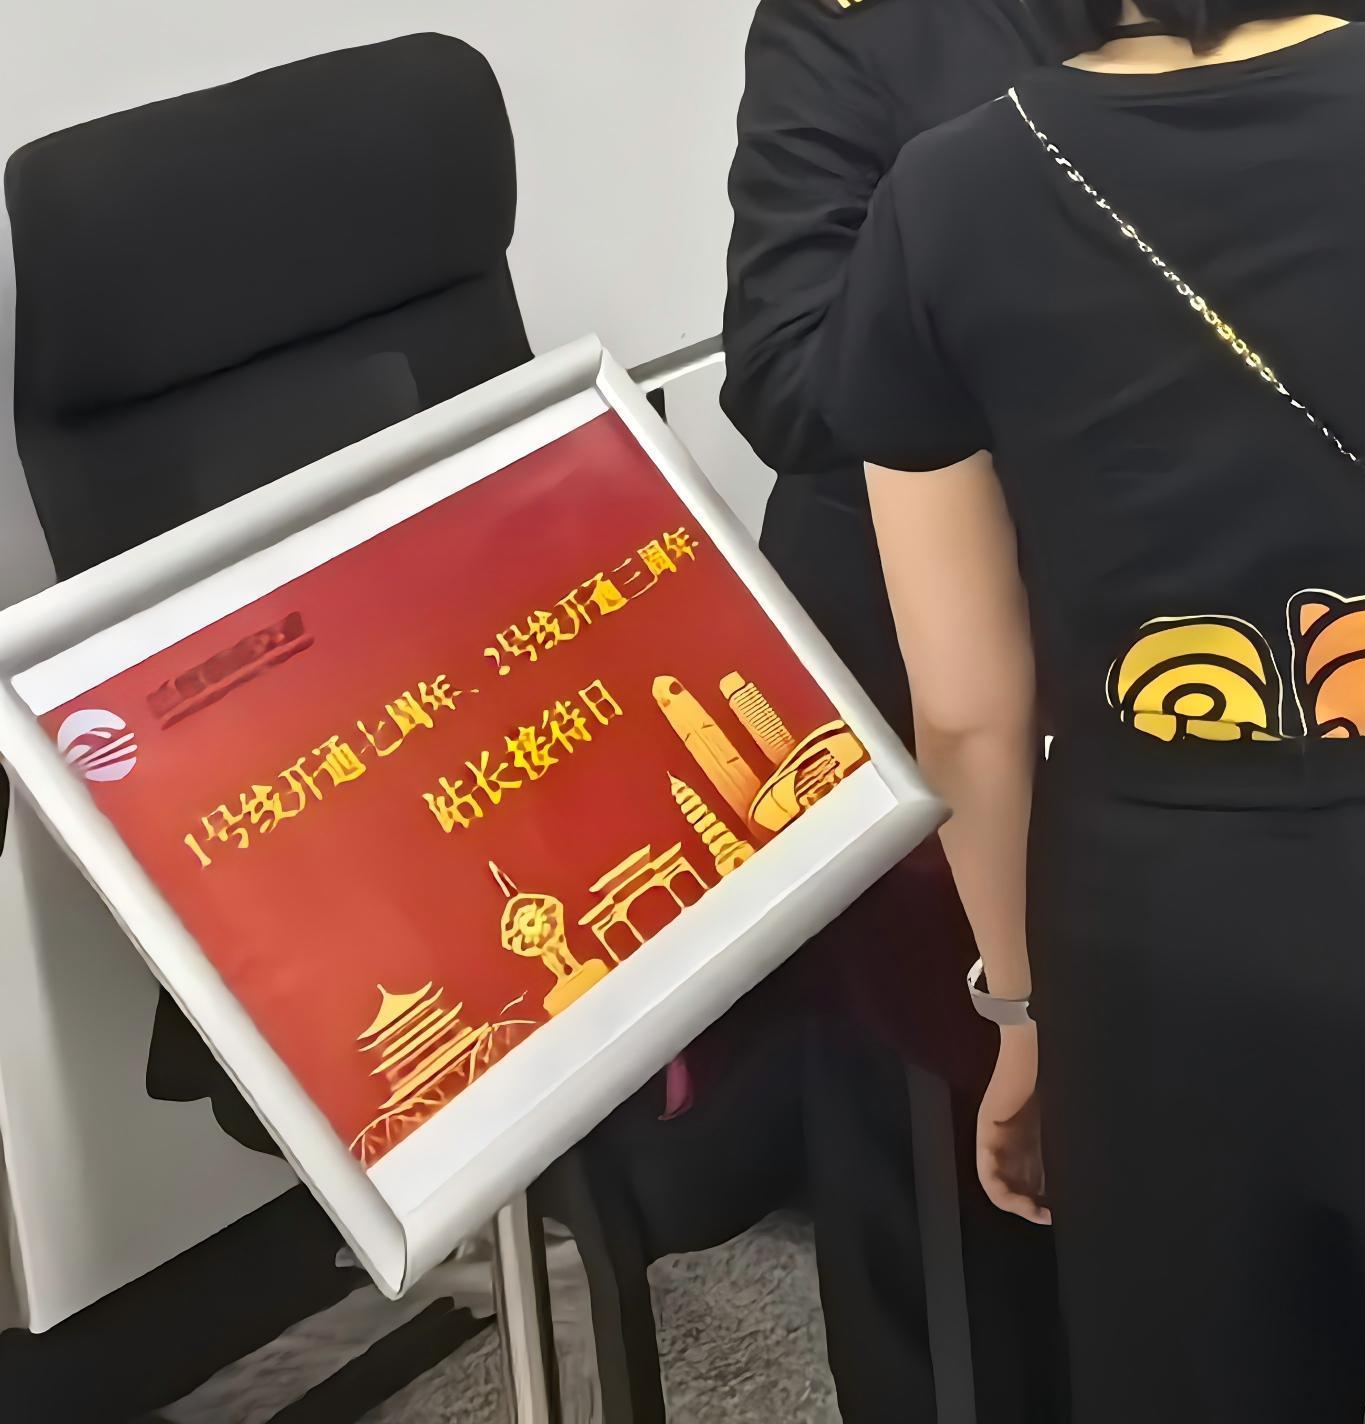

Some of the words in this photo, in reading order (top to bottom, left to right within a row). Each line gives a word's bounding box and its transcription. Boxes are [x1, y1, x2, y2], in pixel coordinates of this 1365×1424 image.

[422, 679, 624, 833] 站长接待日
